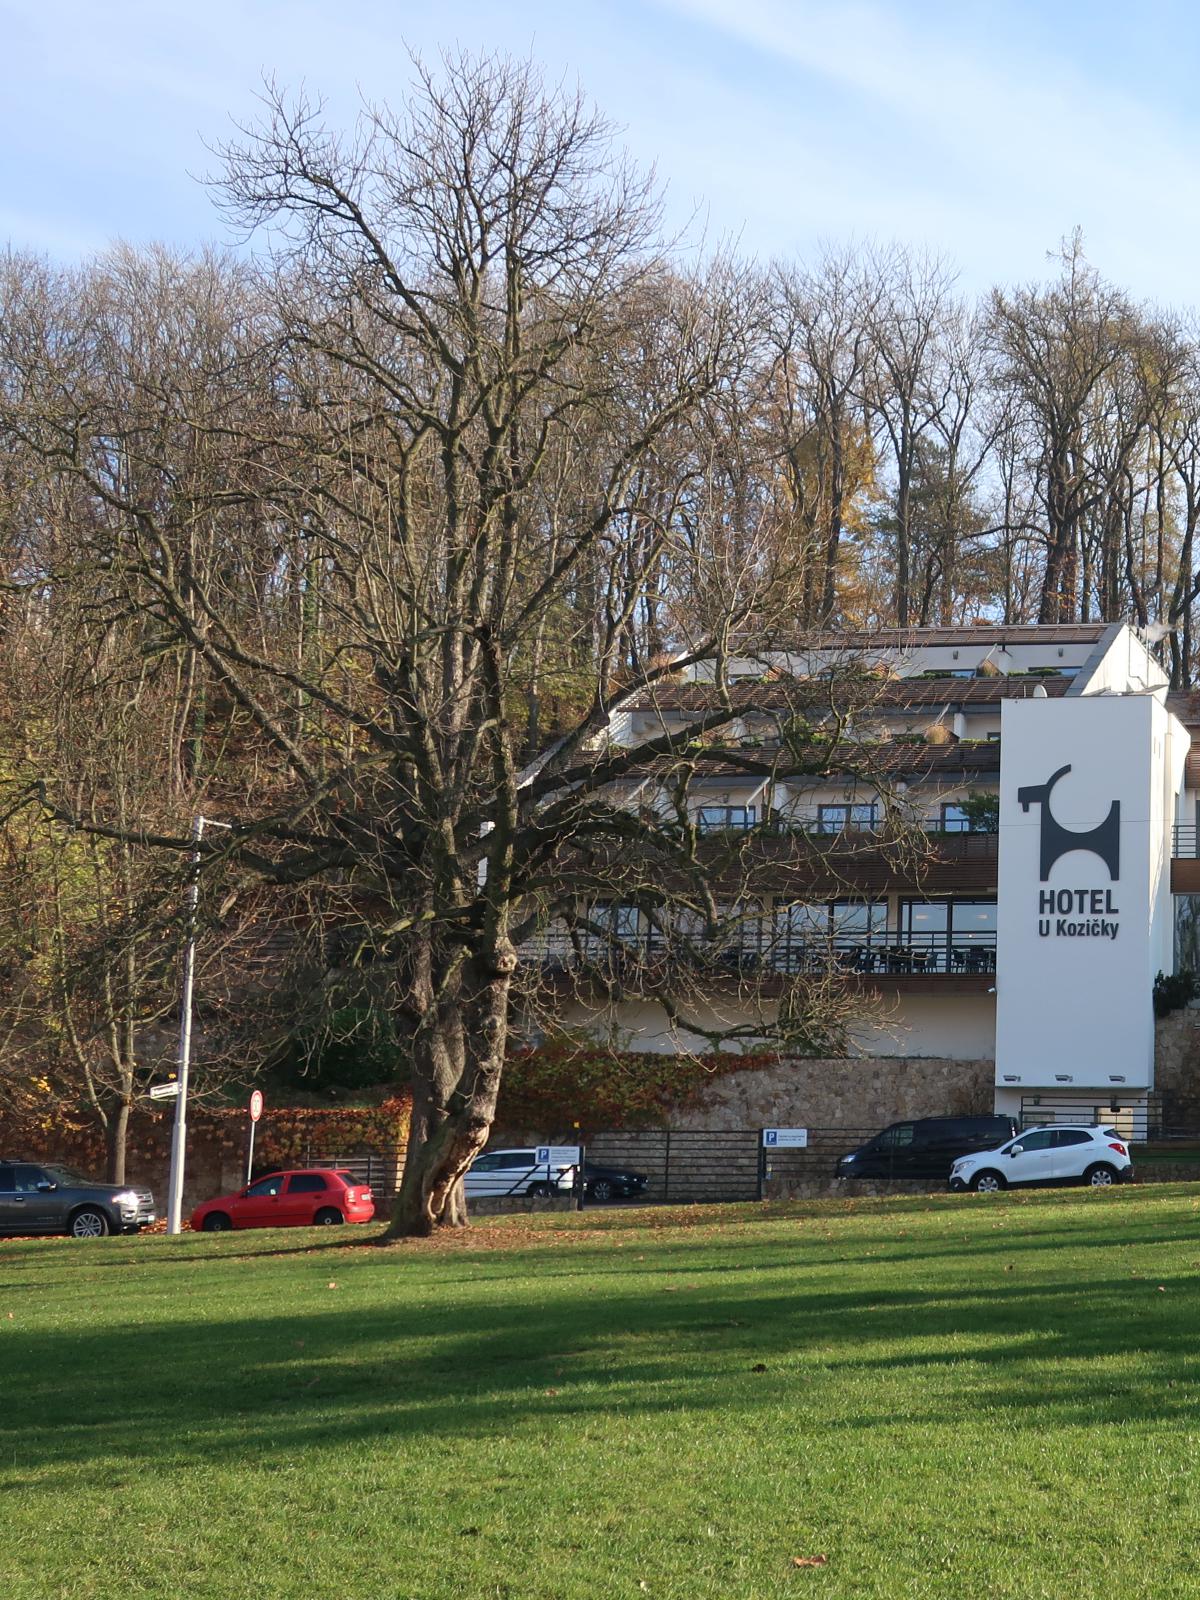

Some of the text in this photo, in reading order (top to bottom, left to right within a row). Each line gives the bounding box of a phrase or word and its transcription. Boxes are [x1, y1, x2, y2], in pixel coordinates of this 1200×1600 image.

[1039, 889, 1119, 915] HOTEL
[1038, 918, 1119, 940] U Kozičky
